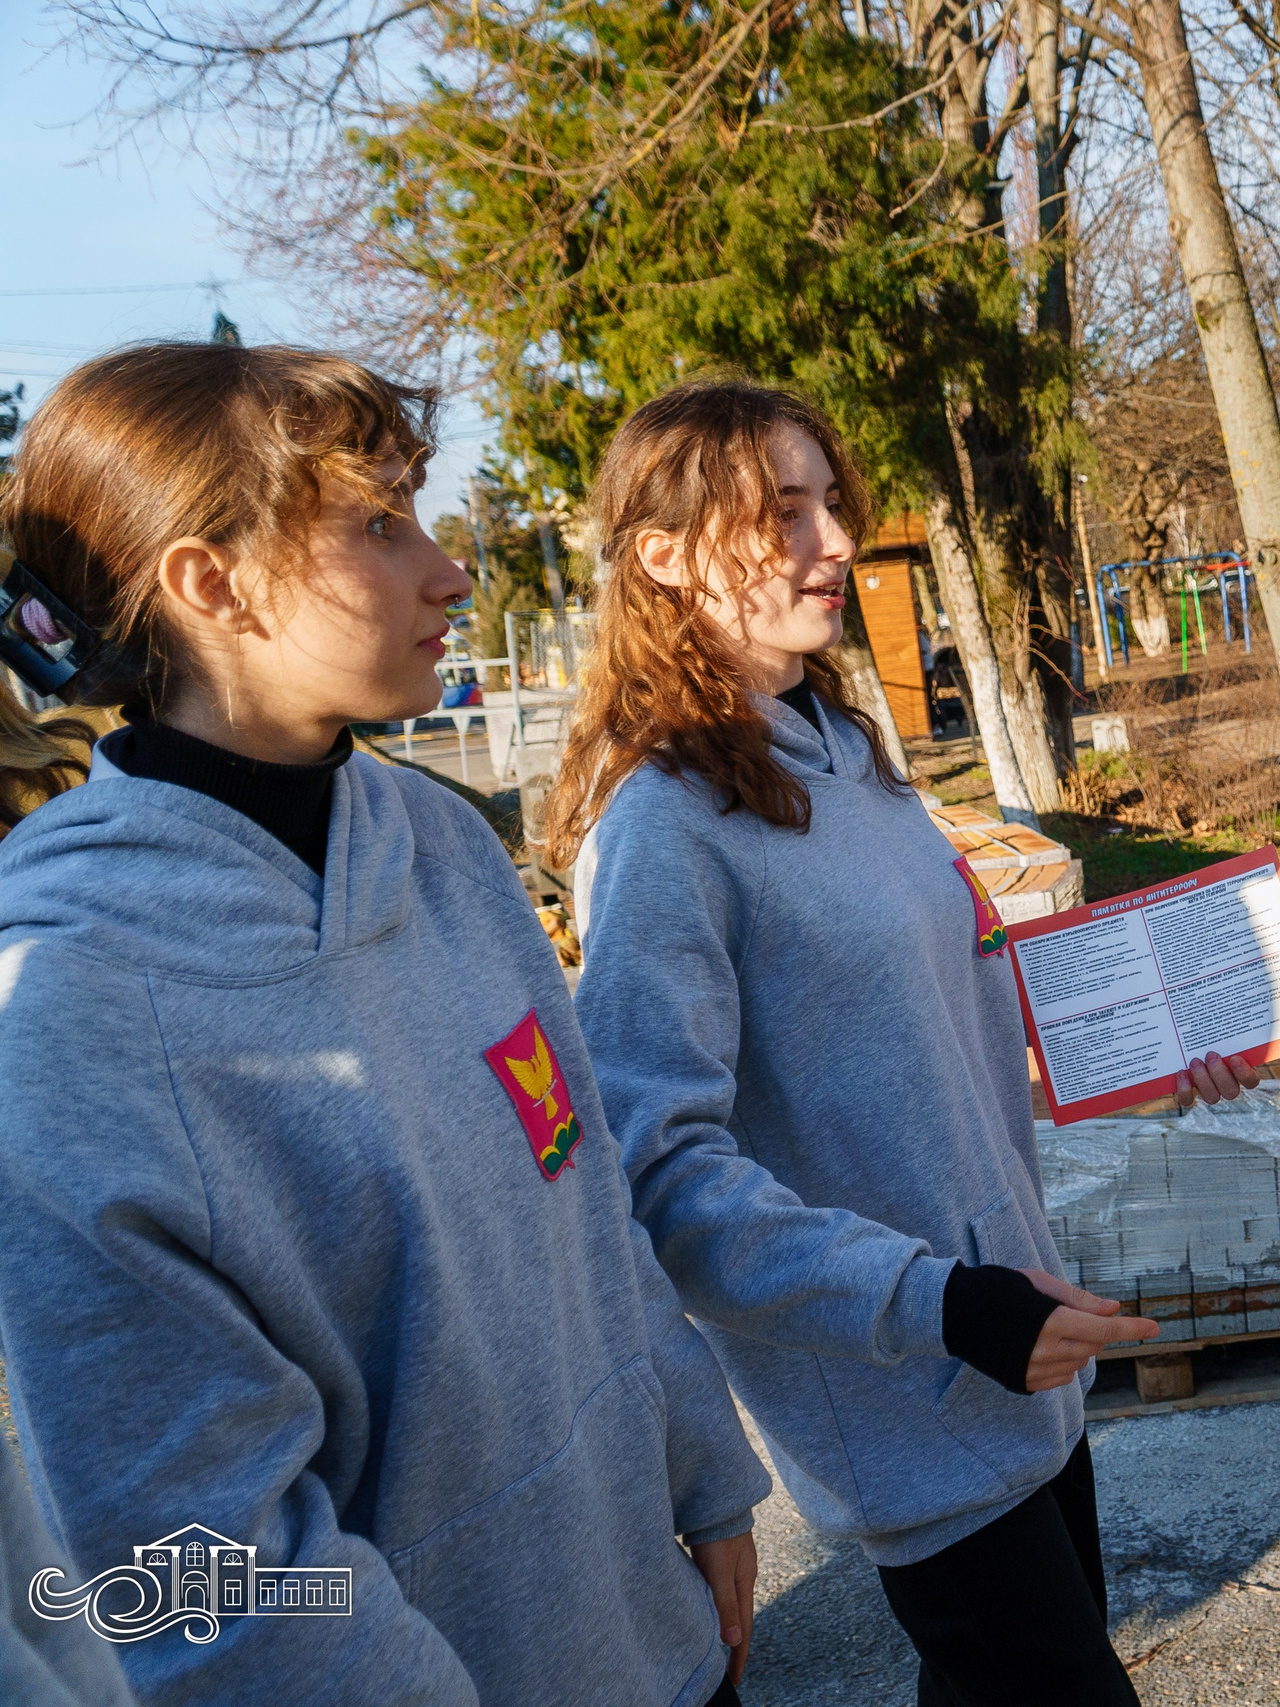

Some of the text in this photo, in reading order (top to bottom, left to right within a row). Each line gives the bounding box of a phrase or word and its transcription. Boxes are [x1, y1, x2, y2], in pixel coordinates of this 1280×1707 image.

[1090, 878, 1198, 917] ПАМЯТКА ПО АНТИТЕРРОРУ
